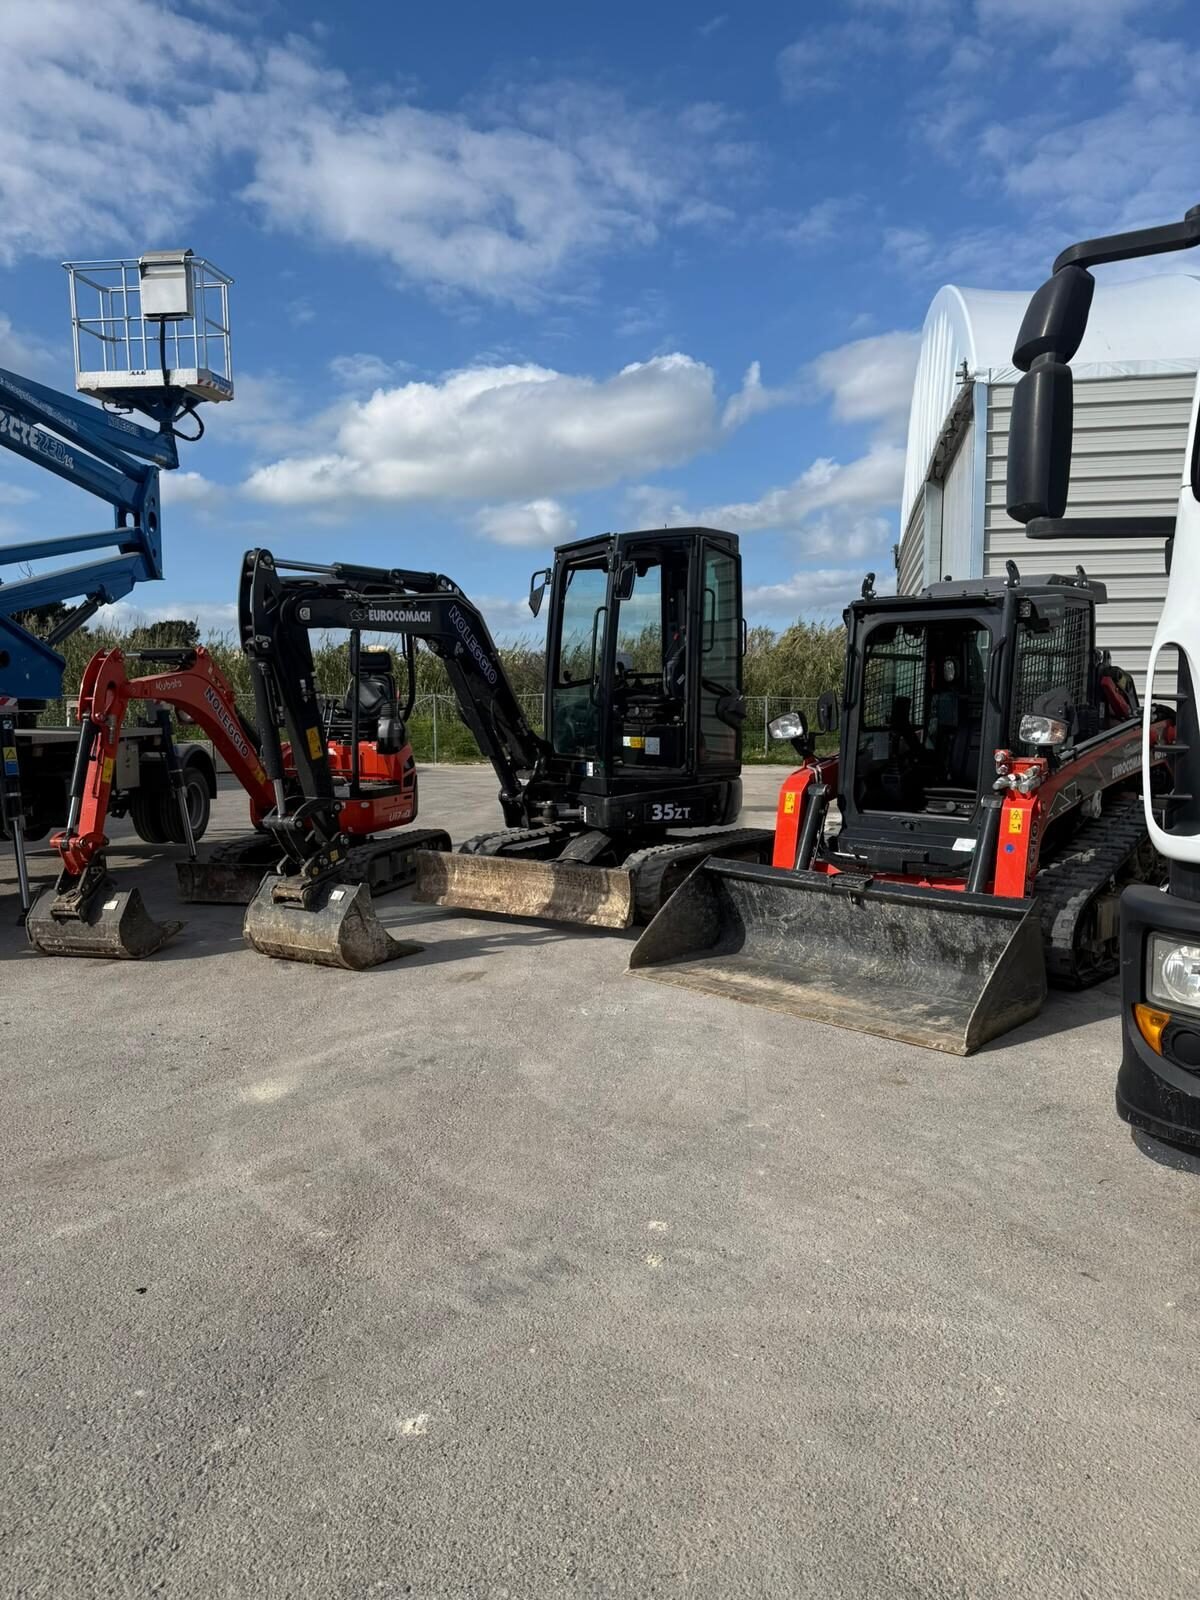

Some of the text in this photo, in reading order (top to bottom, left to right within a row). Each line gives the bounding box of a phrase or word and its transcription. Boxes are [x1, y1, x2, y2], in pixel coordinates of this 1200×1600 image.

[368, 609, 431, 622] EUROCOMACH
[448, 604, 497, 684] NOLEGGIO
[203, 685, 249, 758] NOLEGGIO
[651, 803, 691, 820] 35ZT
